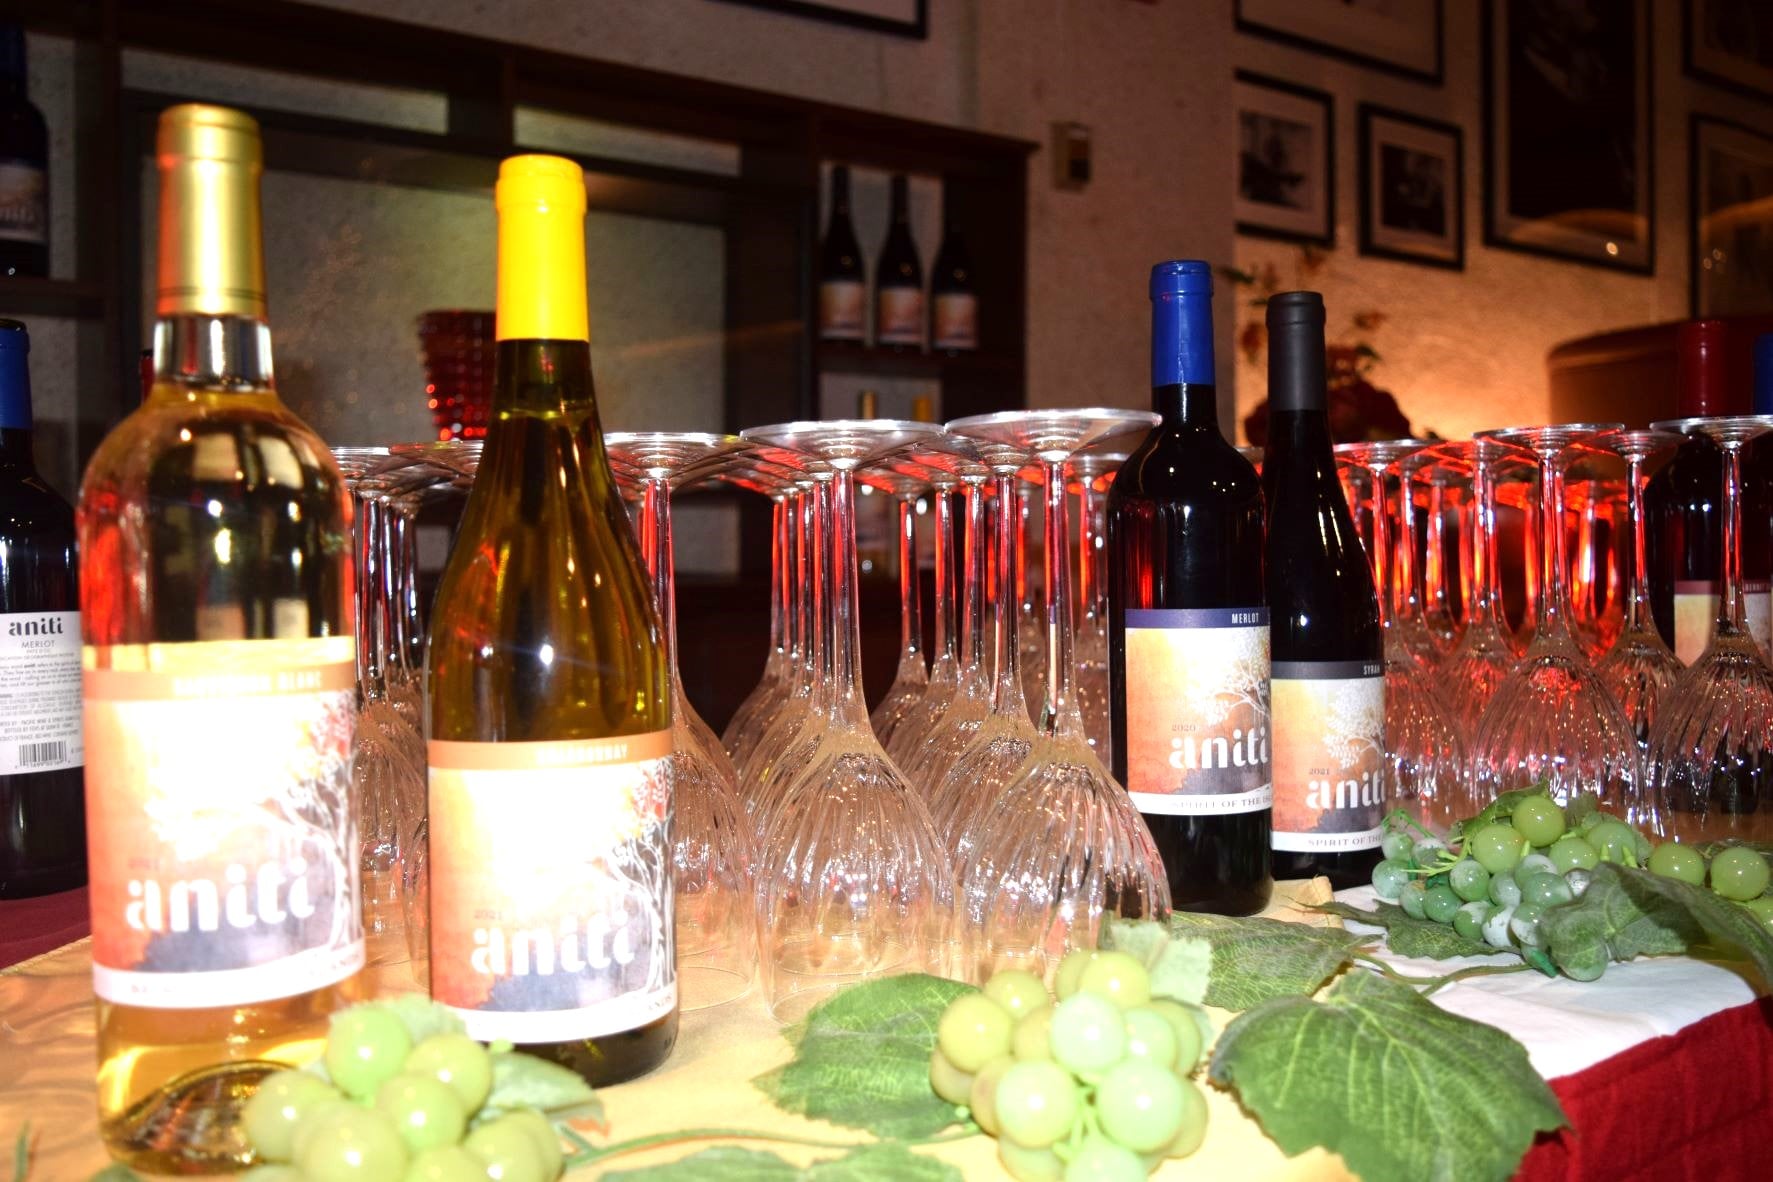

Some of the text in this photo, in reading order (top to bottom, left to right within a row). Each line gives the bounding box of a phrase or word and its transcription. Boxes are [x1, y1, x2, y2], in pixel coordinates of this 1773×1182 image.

[1231, 612, 1260, 624] MERLOT
[9, 617, 64, 636] aniti
[21, 639, 56, 649] MERLOT
[1363, 664, 1381, 676] SYRAH
[1171, 723, 1197, 733] 2020
[536, 743, 628, 765] DONNAY
[1168, 727, 1270, 769] aniti
[1308, 767, 1330, 776] 2021
[1305, 769, 1387, 809] aniti
[1171, 800, 1216, 809] SPIRIT
[1221, 799, 1238, 808] OF
[1241, 797, 1260, 807] THE
[1307, 838, 1350, 847] SPIRIT
[1352, 837, 1366, 846] OF
[124, 856, 316, 932] aniti
[469, 907, 636, 976] aniti
